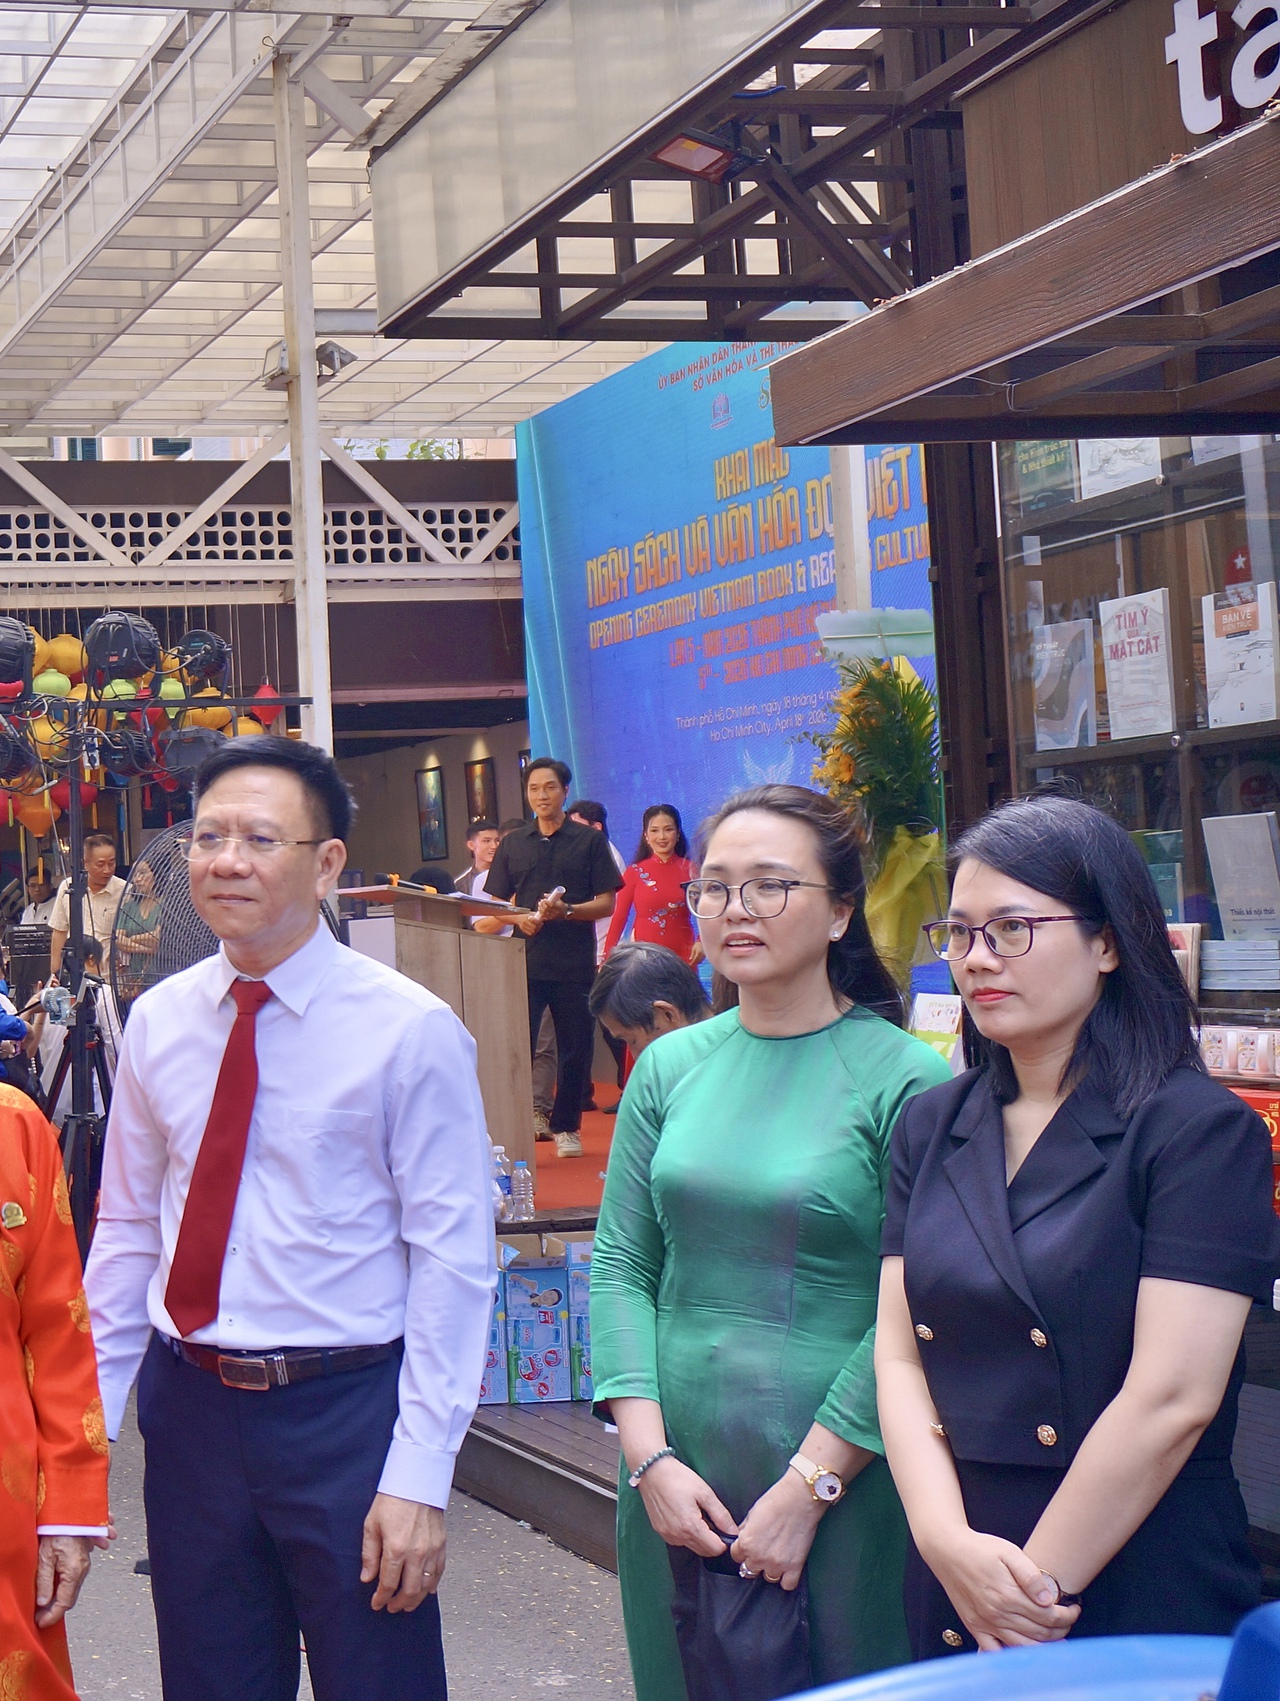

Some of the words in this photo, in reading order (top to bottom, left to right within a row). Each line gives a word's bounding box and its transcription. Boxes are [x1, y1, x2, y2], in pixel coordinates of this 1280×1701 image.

[670, 368, 686, 384] BAN
[687, 355, 710, 376] NHÂN
[712, 346, 729, 365] DÂN
[714, 448, 752, 502] KHAI
[633, 528, 682, 595] SÁCH
[684, 514, 712, 577] VÀ
[713, 502, 755, 568] VĂN
[758, 484, 802, 555] HÓA
[806, 473, 835, 540] ĐỌ
[589, 610, 633, 649] OPENING
[634, 592, 697, 638] CEREMONY
[699, 574, 755, 619] VIETNAM
[757, 563, 794, 603] BOOK
[795, 559, 807, 593] &
[1115, 610, 1138, 630] TÌM
[1140, 606, 1150, 626] Ý
[1222, 610, 1239, 624] BẢN
[1127, 629, 1140, 639] QUA
[1137, 631, 1161, 656] CẮT
[676, 715, 699, 730] Thành
[792, 692, 817, 709] tháng
[735, 722, 754, 738] Minh
[774, 716, 795, 734] April
